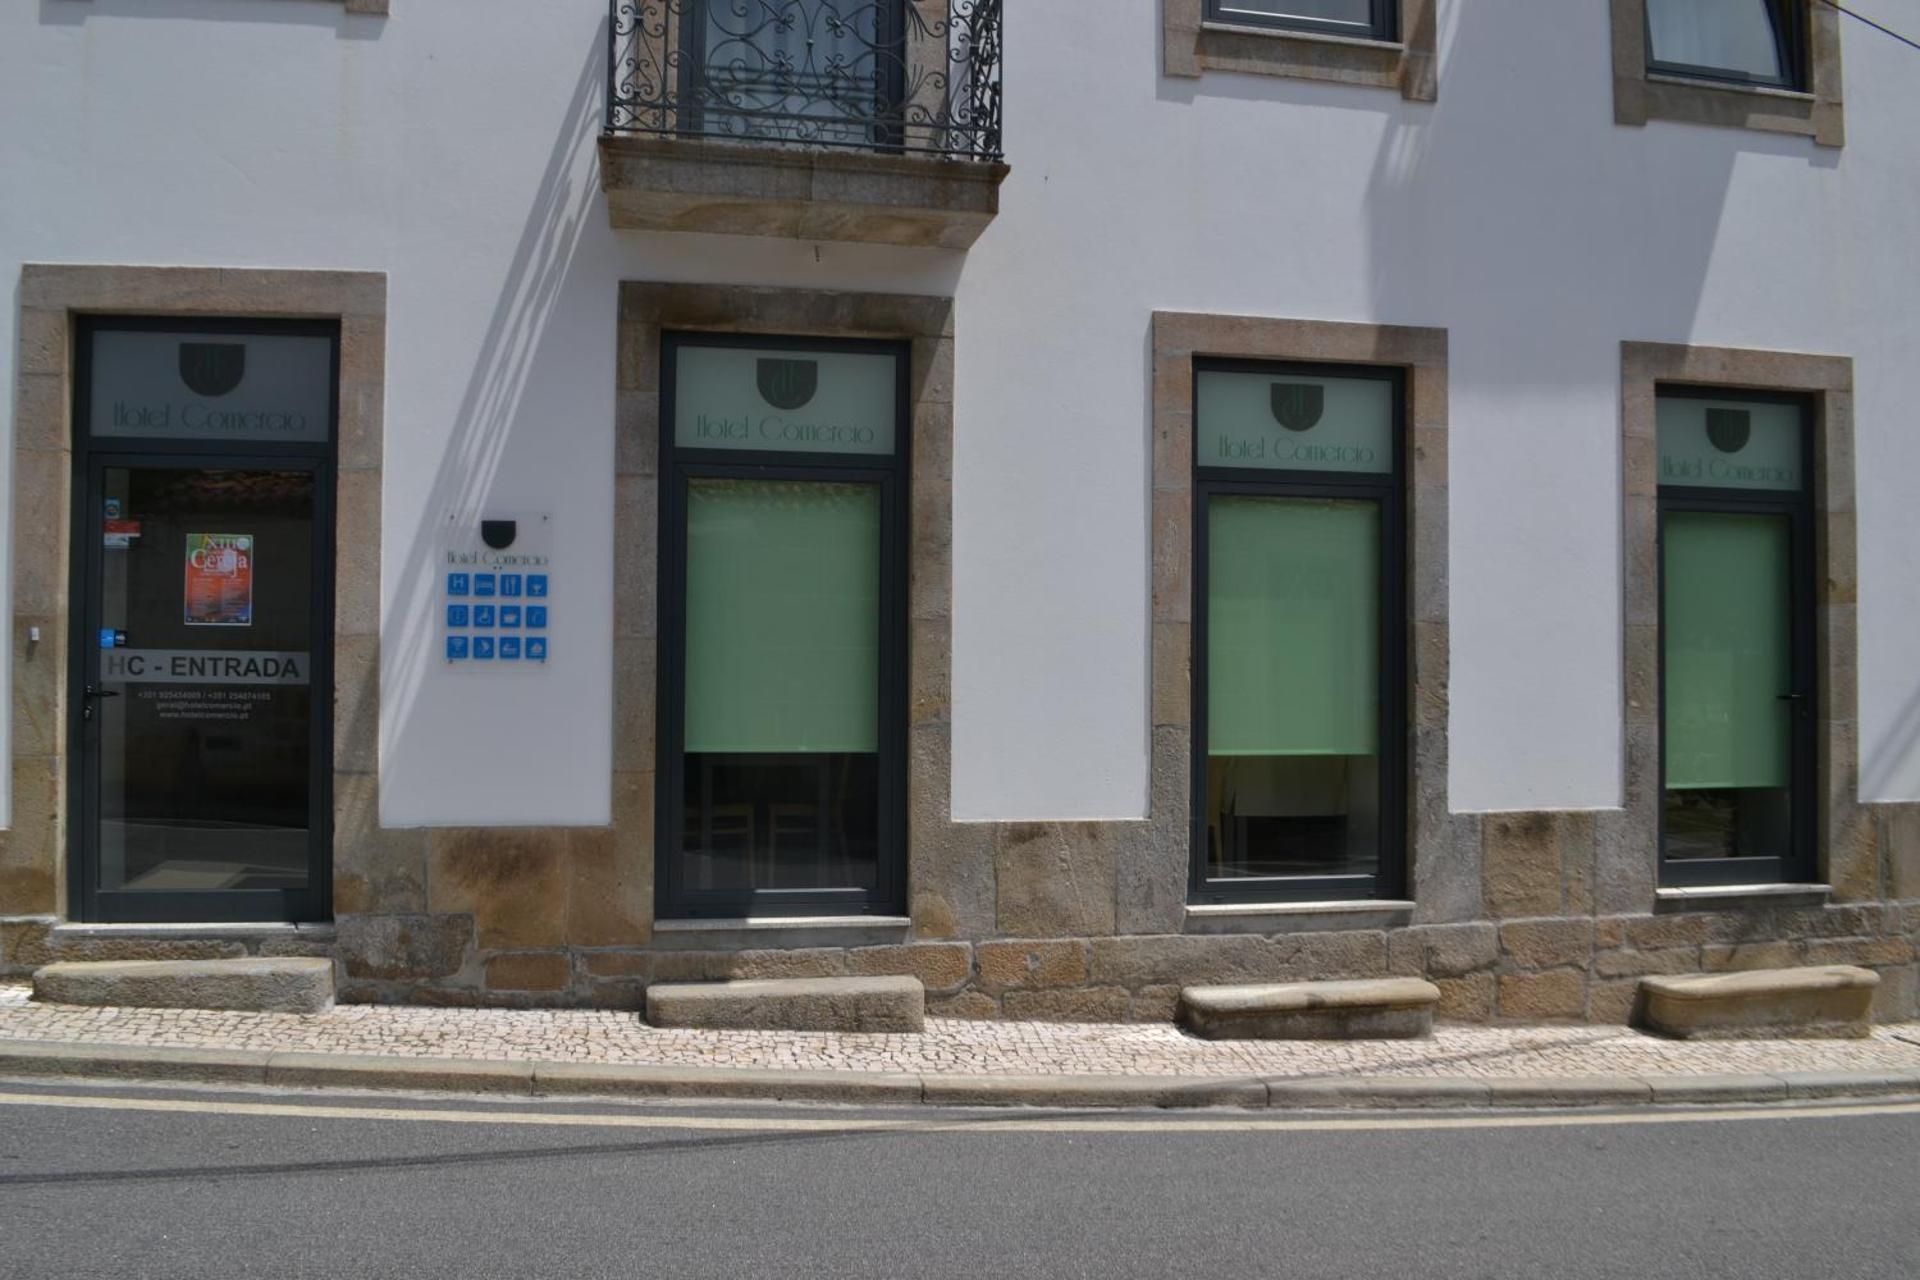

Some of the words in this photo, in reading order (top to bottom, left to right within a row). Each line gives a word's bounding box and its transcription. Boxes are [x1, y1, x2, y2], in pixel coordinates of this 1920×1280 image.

[113, 400, 170, 429] Hotel
[181, 402, 306, 431] Comercio
[696, 414, 749, 439] Hotel
[759, 415, 874, 444] Comercio
[1218, 434, 1265, 459] Hotel
[1274, 437, 1375, 463] Comercio
[1663, 455, 1702, 479] Hotel
[1709, 458, 1794, 482] Comercio
[191, 549, 249, 579] Cerja
[447, 551, 477, 565] Hotel
[482, 551, 549, 566] Comercio
[107, 655, 145, 676] HC
[170, 655, 300, 678] ENTRADA
